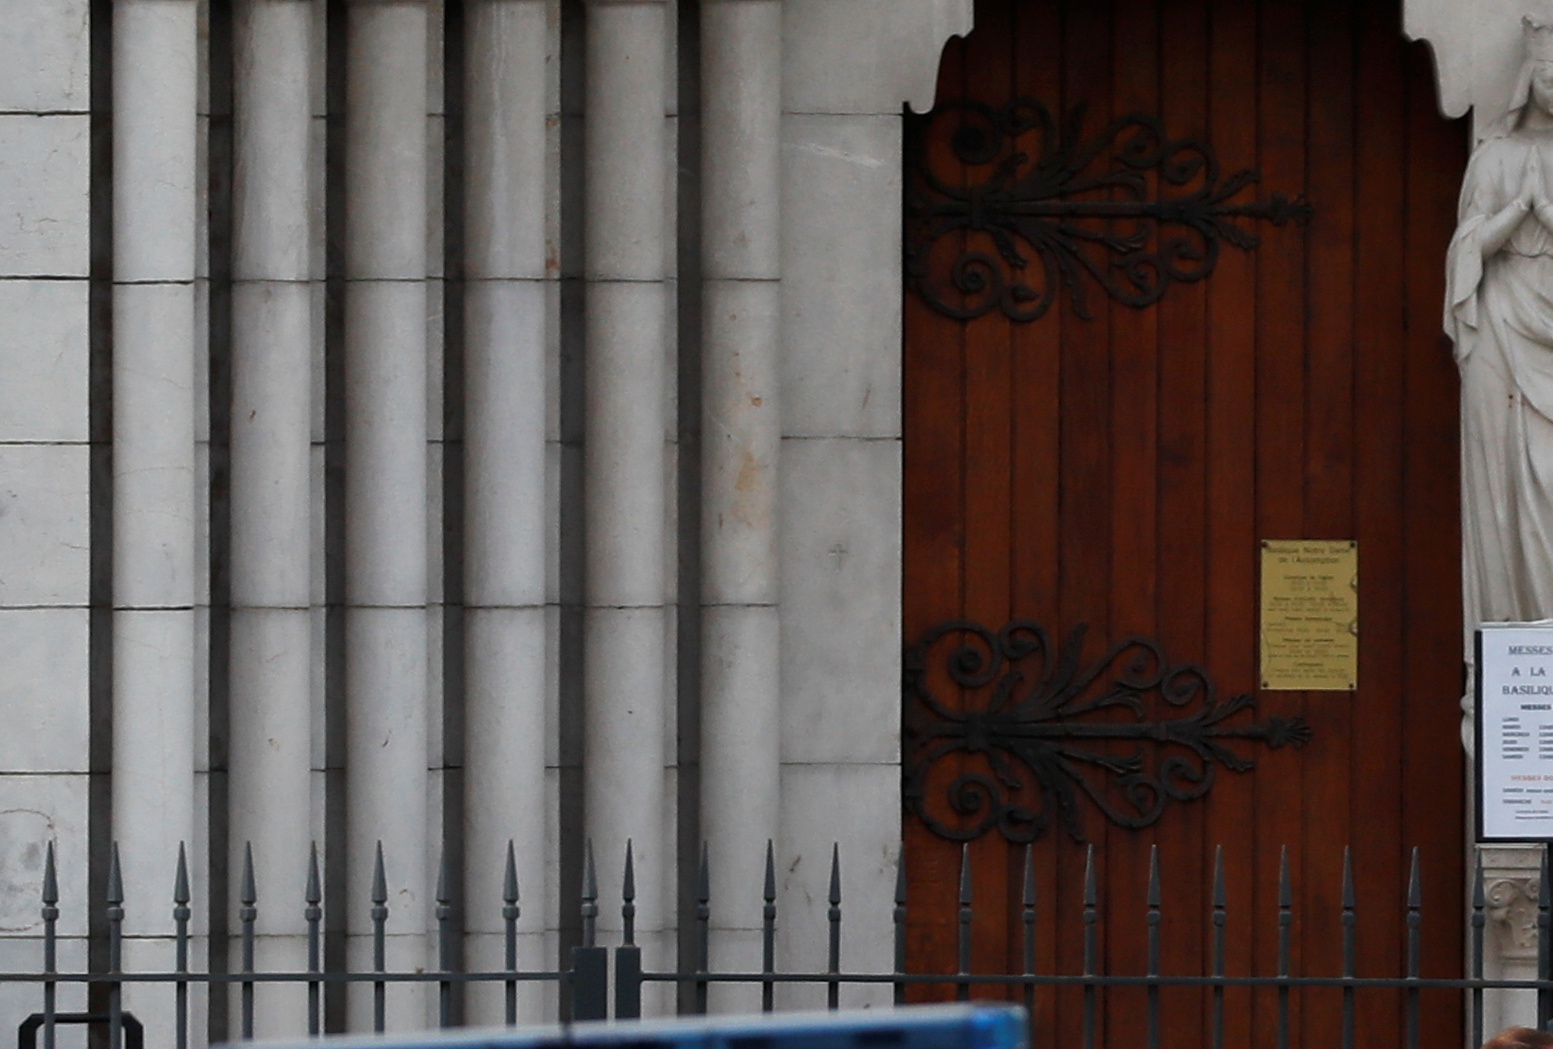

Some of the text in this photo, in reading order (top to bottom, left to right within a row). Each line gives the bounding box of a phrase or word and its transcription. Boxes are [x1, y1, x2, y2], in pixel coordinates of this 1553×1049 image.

[1508, 645, 1553, 656] MESSES
[1511, 667, 1546, 677] A LA
